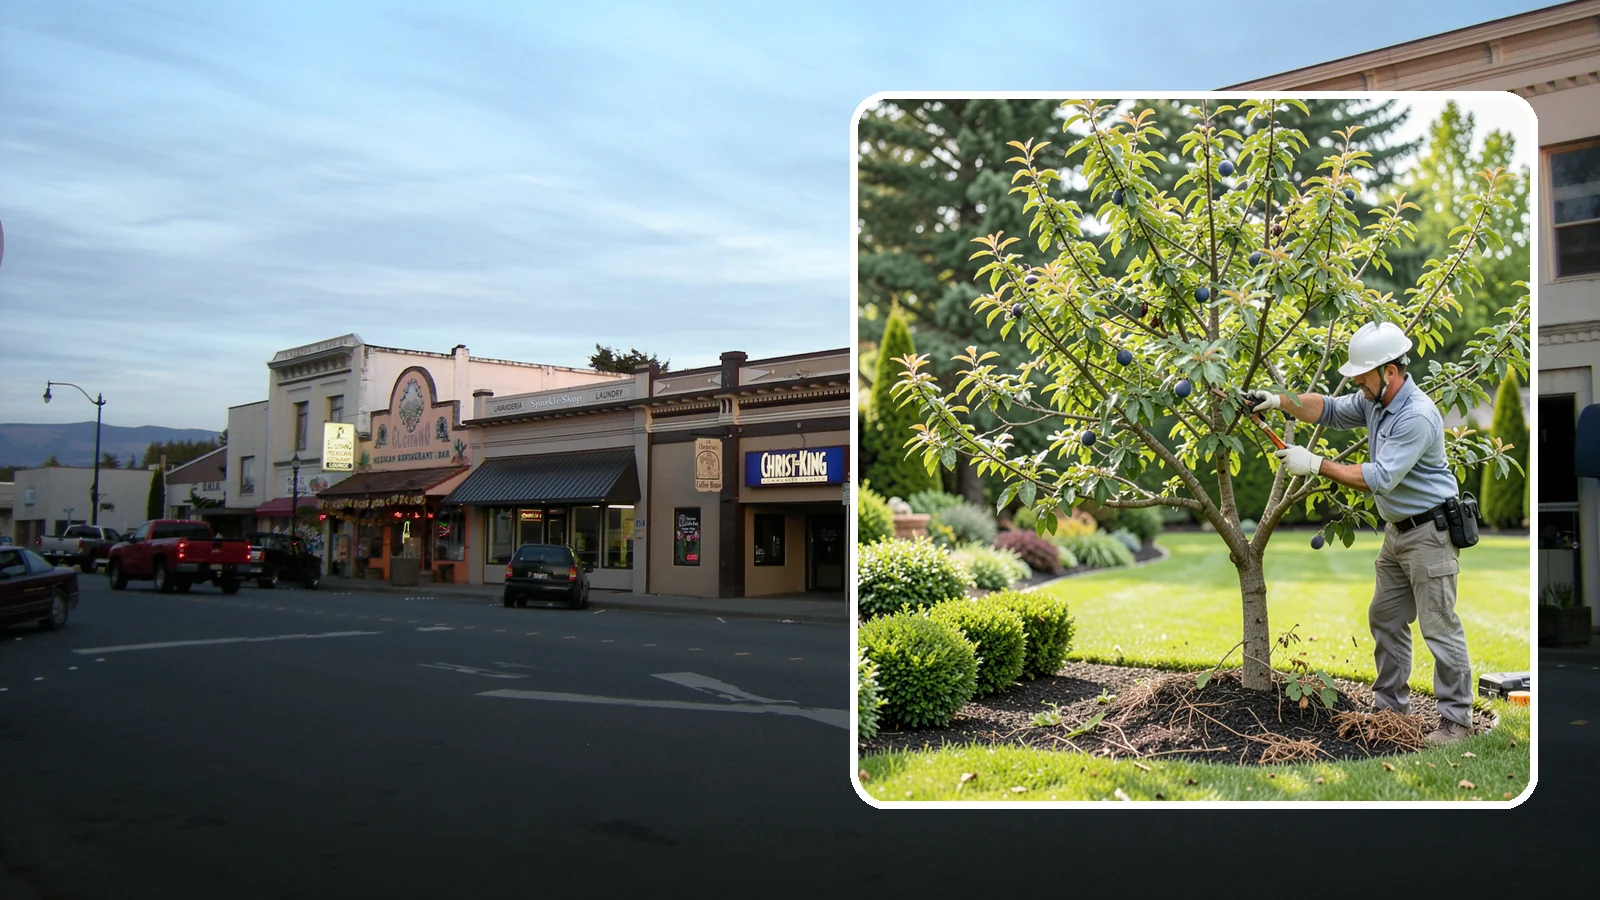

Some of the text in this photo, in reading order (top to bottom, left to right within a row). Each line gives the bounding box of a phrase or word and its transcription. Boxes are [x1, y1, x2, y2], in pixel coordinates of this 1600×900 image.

[596, 389, 624, 400] LAUNDRY
[494, 402, 522, 412] LAVANDERIA
[530, 394, 583, 410] Sparkle Shop
[373, 455, 396, 464] MEXICAN
[397, 452, 434, 463] RESTAURANT
[438, 450, 450, 459] BAR
